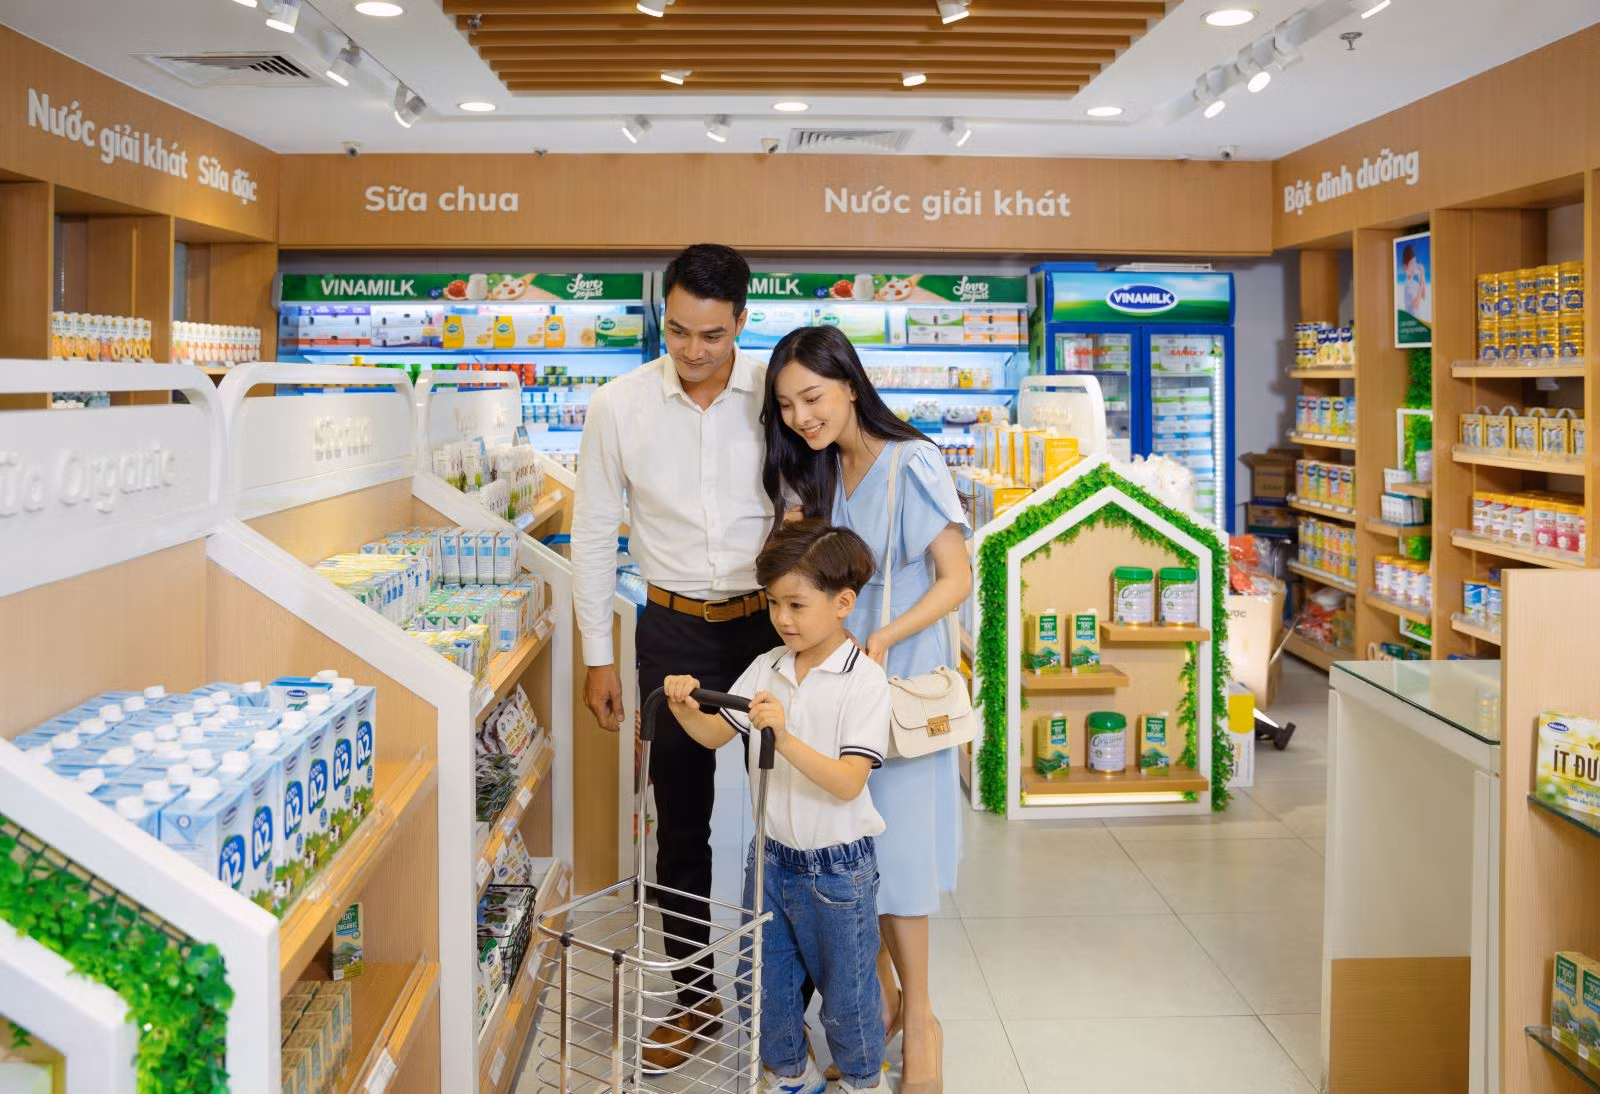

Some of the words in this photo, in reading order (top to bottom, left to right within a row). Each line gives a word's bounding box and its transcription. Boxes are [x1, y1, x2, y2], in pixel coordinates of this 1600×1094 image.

[28, 88, 95, 147] Nước
[100, 124, 139, 164] giải
[144, 133, 188, 179] khát
[198, 155, 228, 192] Sữa
[1284, 179, 1312, 216] Bột
[1316, 165, 1353, 202] dinh
[1356, 147, 1420, 189] dưỡng
[365, 185, 427, 212] Sữa
[438, 186, 519, 212] chua
[824, 186, 911, 213] Nước
[921, 187, 982, 221] giải
[994, 189, 1071, 217] khát
[321, 279, 415, 296] VINAMILK
[748, 278, 800, 295] MILK
[1113, 292, 1171, 304] VINAMILK
[357, 734, 371, 763] A2
[1554, 745, 1569, 774] ÍT
[1573, 754, 1600, 781] ĐƯ
[335, 752, 350, 785] A2
[310, 773, 325, 808] A2
[286, 796, 302, 833] A2
[254, 822, 272, 862] A2
[221, 852, 241, 888] A2
